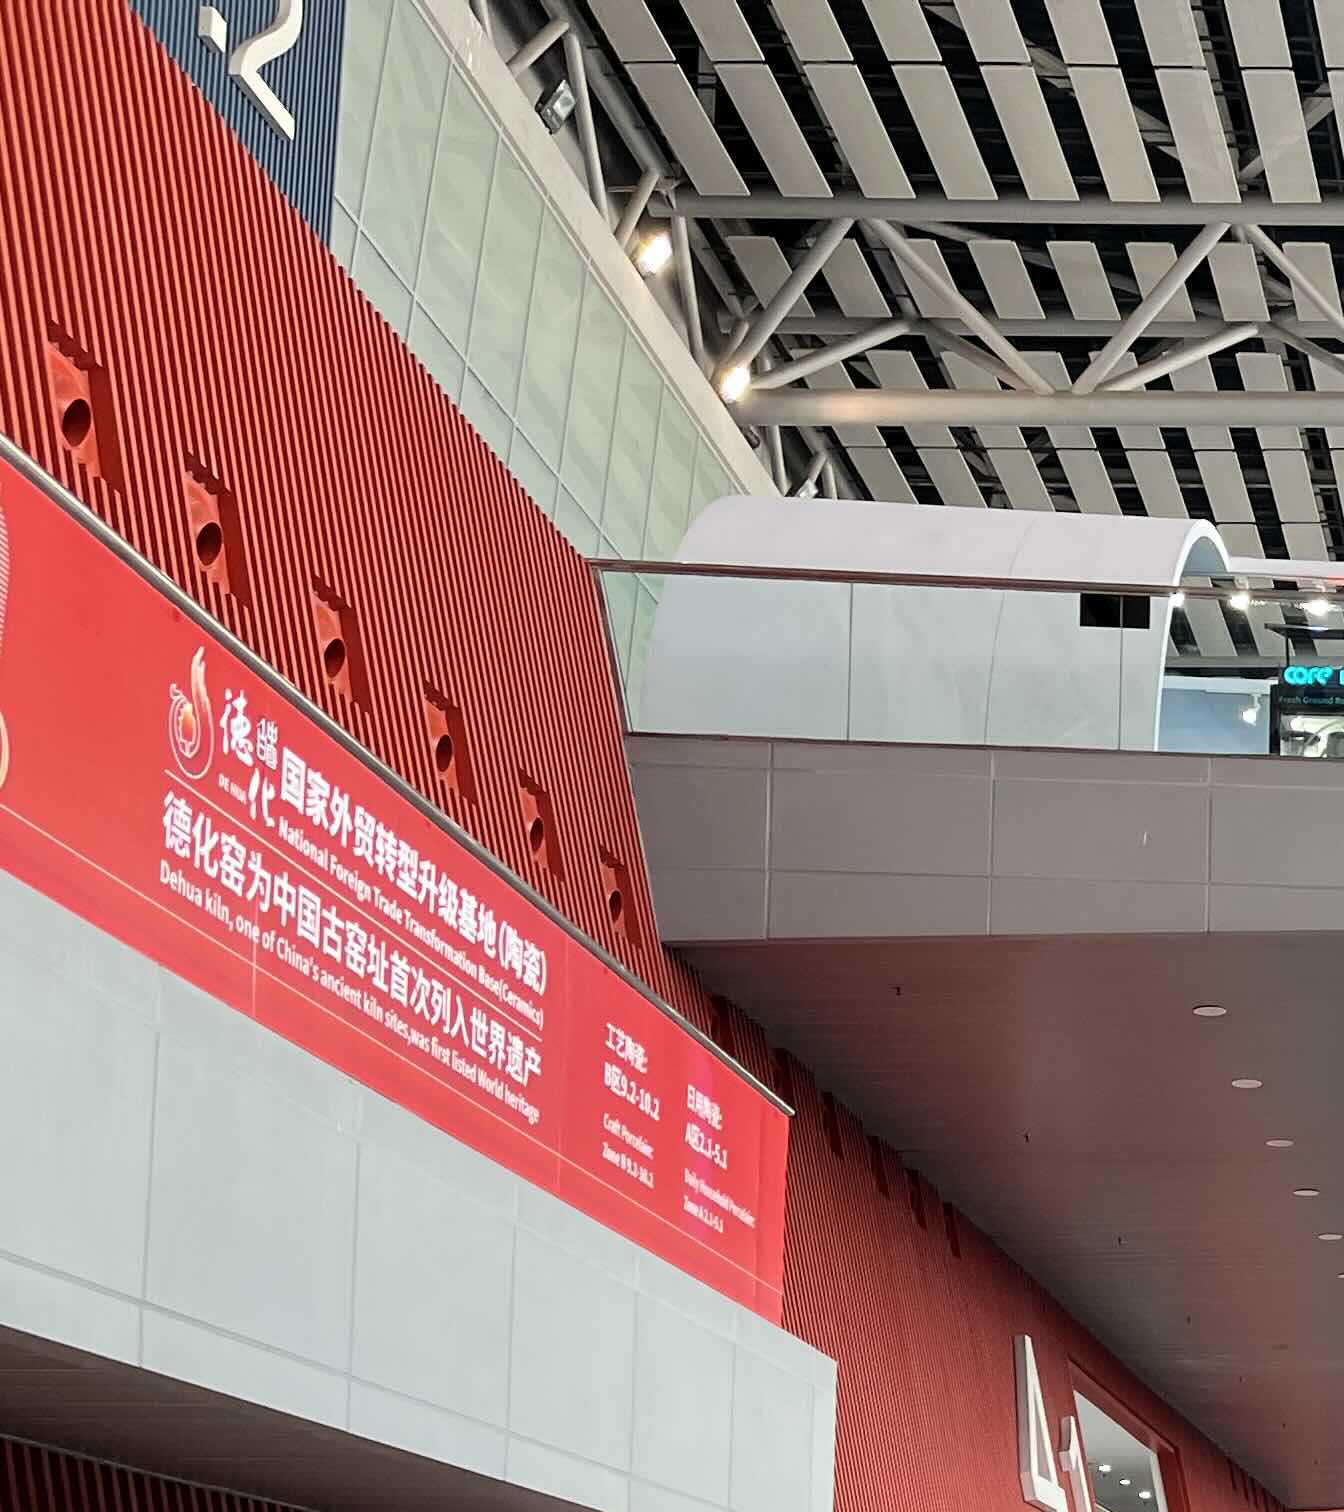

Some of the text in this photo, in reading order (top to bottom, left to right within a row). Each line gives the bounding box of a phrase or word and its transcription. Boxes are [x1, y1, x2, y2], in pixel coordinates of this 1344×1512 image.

[160, 858, 203, 907] Dehua
[205, 888, 234, 932] kiln,
[236, 915, 260, 943] one
[262, 930, 276, 952] of
[276, 936, 320, 982] China's
[320, 970, 362, 1011] ancient
[363, 991, 384, 1023] kiln
[431, 1036, 451, 1067] first
[452, 1049, 477, 1083] listed
[478, 1067, 504, 1101] World
[504, 1084, 540, 1126] heritage
[279, 816, 329, 871] National
[330, 854, 372, 902] Foreign
[373, 886, 403, 924] Trade
[404, 909, 478, 980] Transformation
